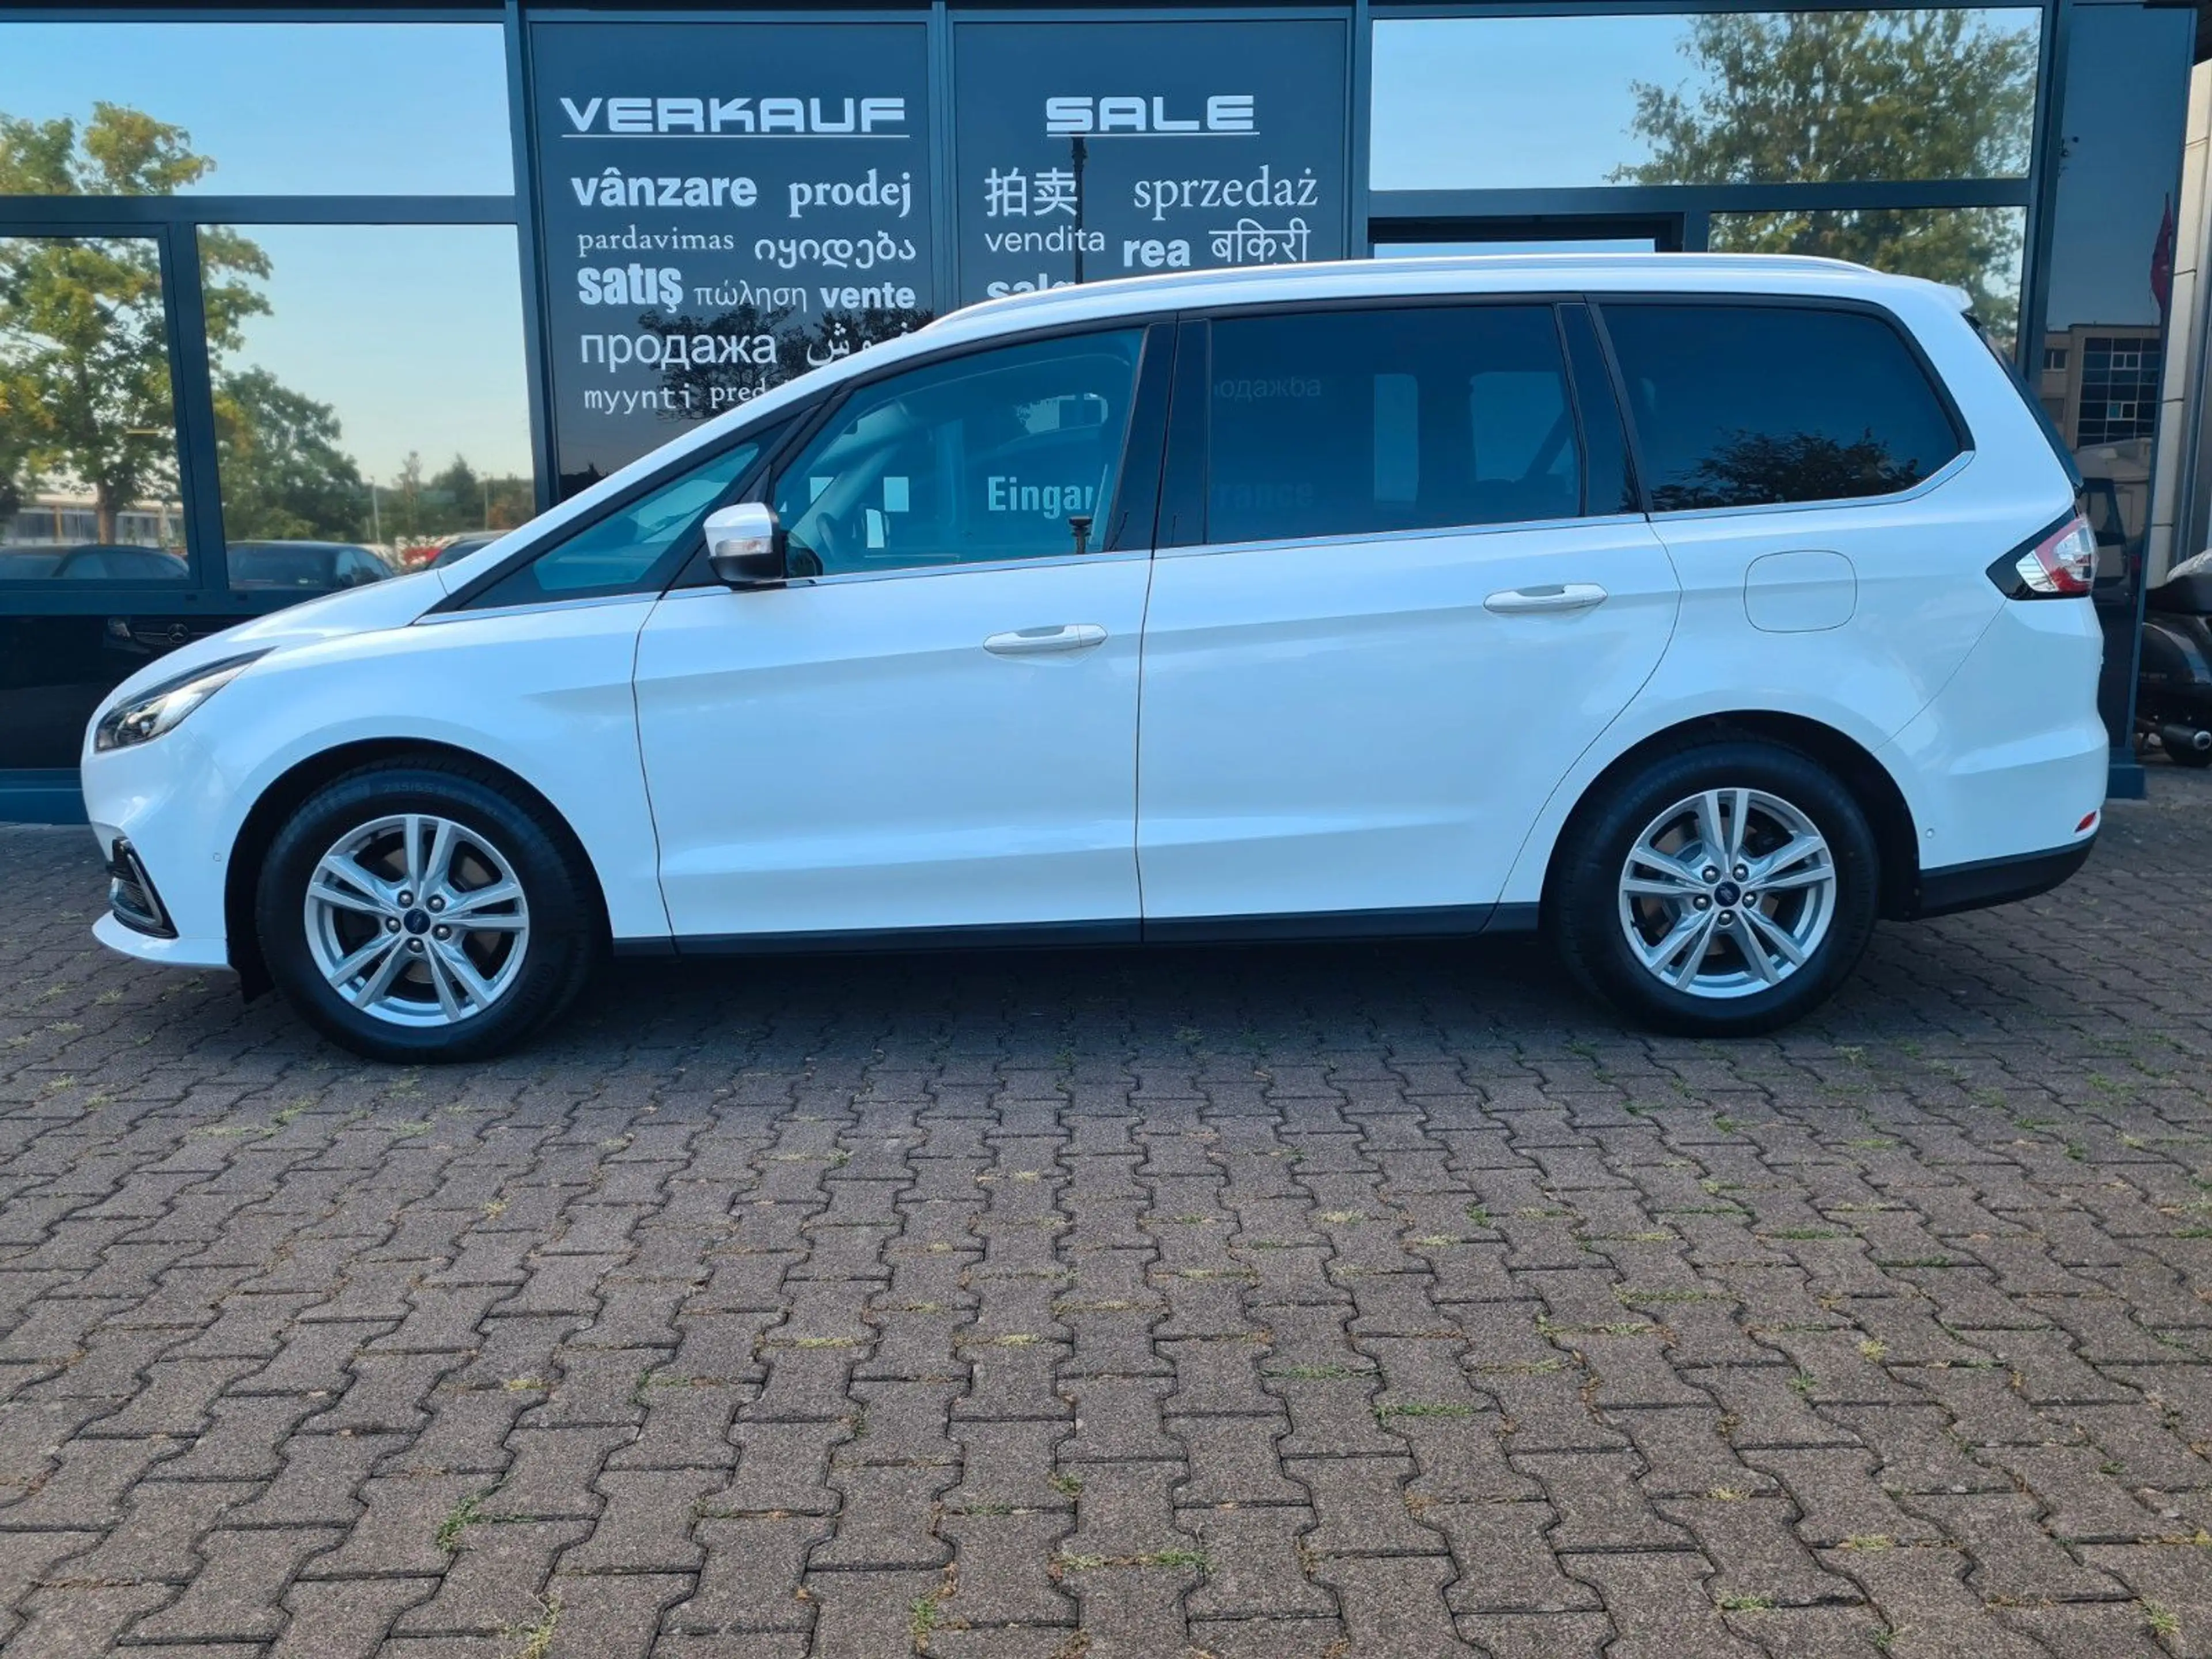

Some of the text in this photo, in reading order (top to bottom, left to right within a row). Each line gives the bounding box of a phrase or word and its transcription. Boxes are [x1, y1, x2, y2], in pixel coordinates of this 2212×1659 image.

[560, 97, 905, 132] VERKAUF
[1046, 95, 1254, 131] SALE
[571, 167, 757, 207] vânzare
[789, 168, 911, 217] prodej
[984, 167, 1077, 217] 拍卖
[1134, 165, 1319, 221] sprzedaż
[577, 225, 734, 257] pardavimas
[755, 231, 916, 268] იყიდება
[984, 225, 1105, 252] vendita
[1124, 239, 1191, 267] rea
[577, 263, 683, 313] satış
[694, 280, 807, 312] πώληση
[820, 282, 915, 309] vente
[987, 273, 1075, 298] sal
[581, 334, 777, 373] продажа
[585, 384, 692, 415] myynti
[1214, 376, 1322, 403] одажба
[1211, 482, 1315, 509] rance
